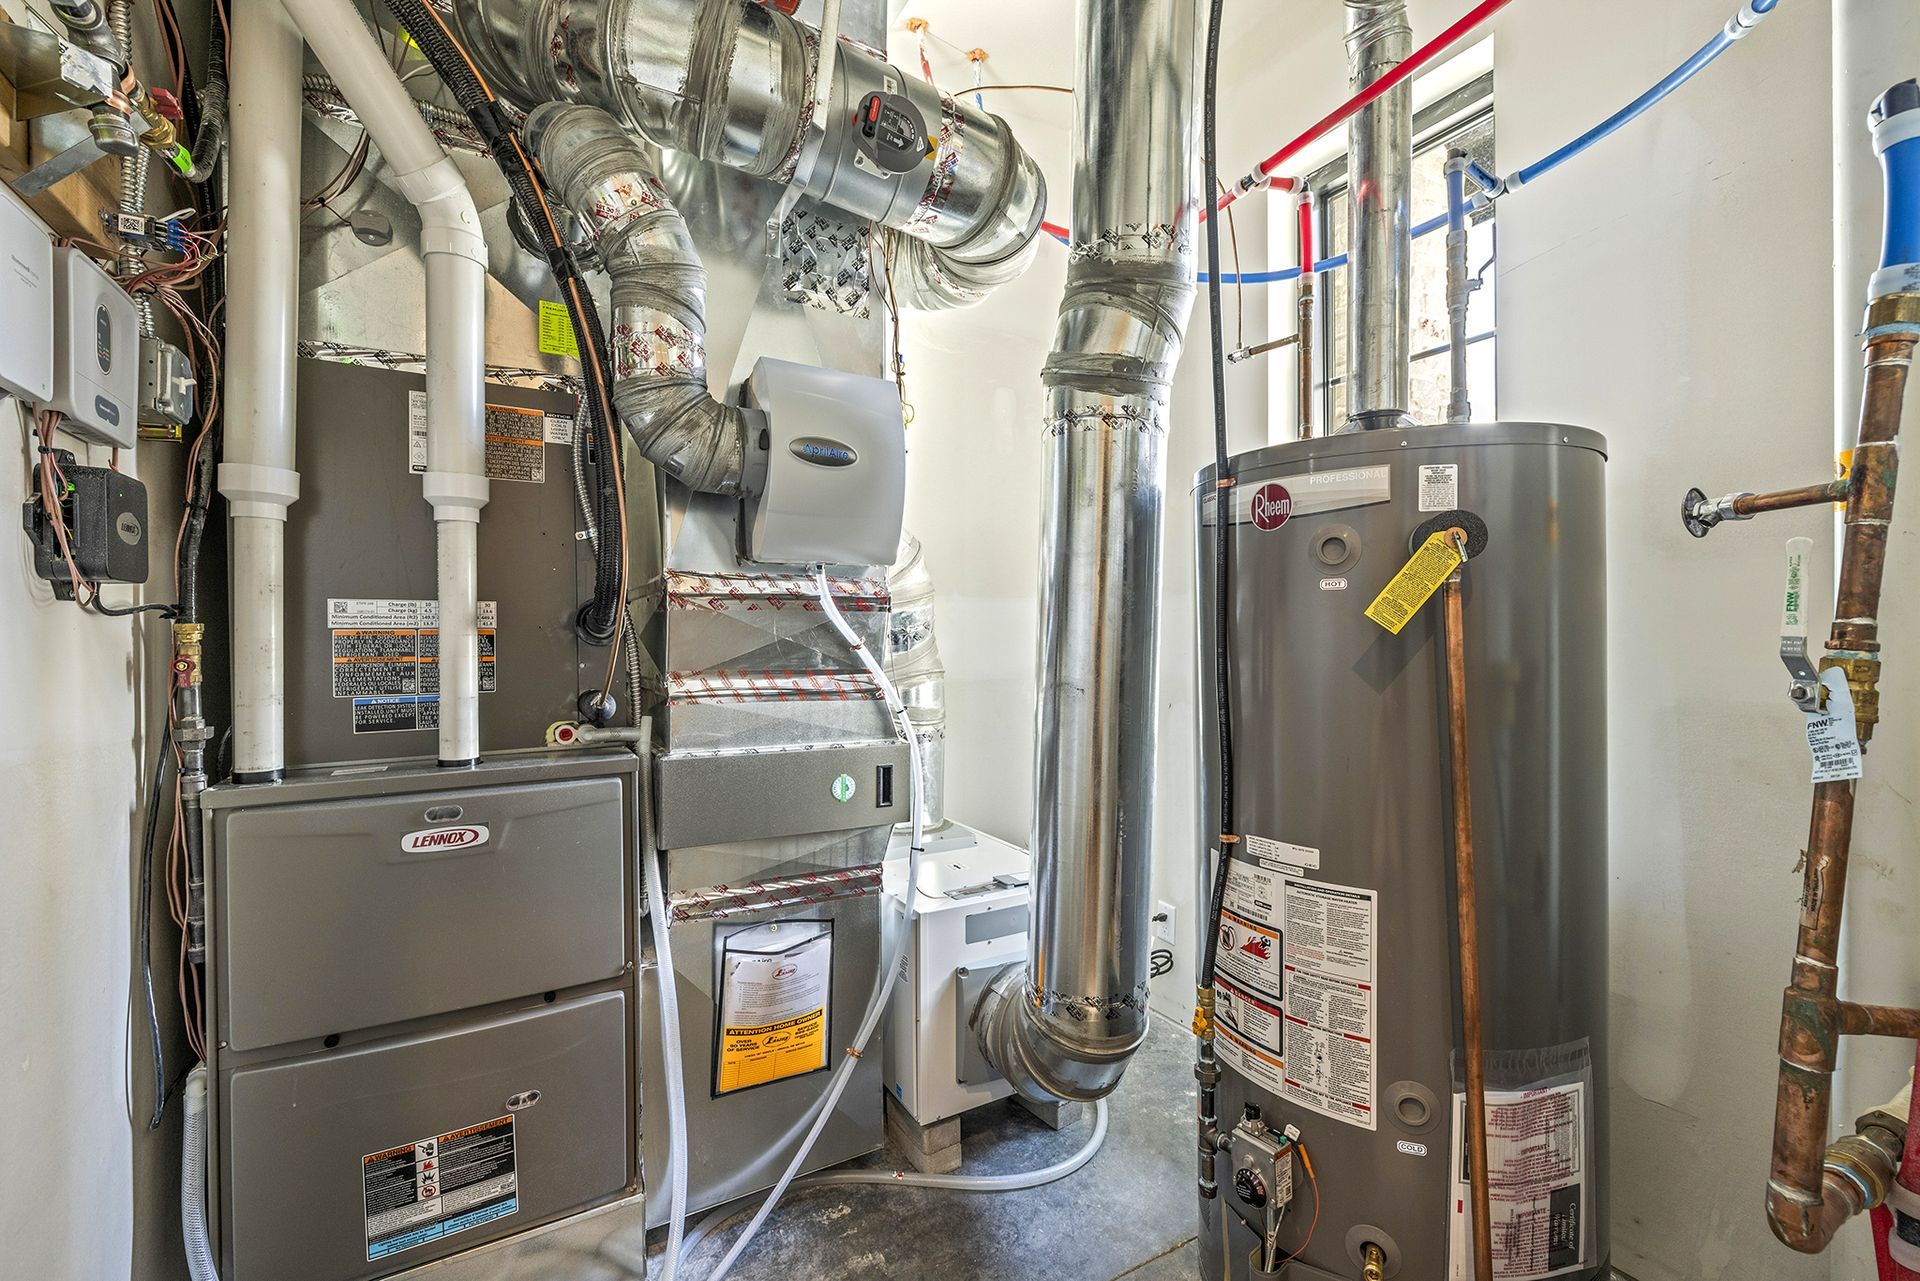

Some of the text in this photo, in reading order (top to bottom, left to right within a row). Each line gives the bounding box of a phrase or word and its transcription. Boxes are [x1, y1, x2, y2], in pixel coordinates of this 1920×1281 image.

[1310, 471, 1387, 484] PROFESSIONAL
[1255, 486, 1290, 523] Rheem
[1786, 592, 1794, 612] FNW
[1807, 719, 1828, 730] FNW
[412, 832, 467, 848] LENNOX
[729, 1012, 821, 1035] ATTENTION HOME OWNER
[1523, 1088, 1548, 1098] IMPORTANT
[1401, 1142, 1423, 1152] COLD
[1521, 1144, 1547, 1155] IMPORTANT
[1516, 1208, 1546, 1220] IMPORTANTE
